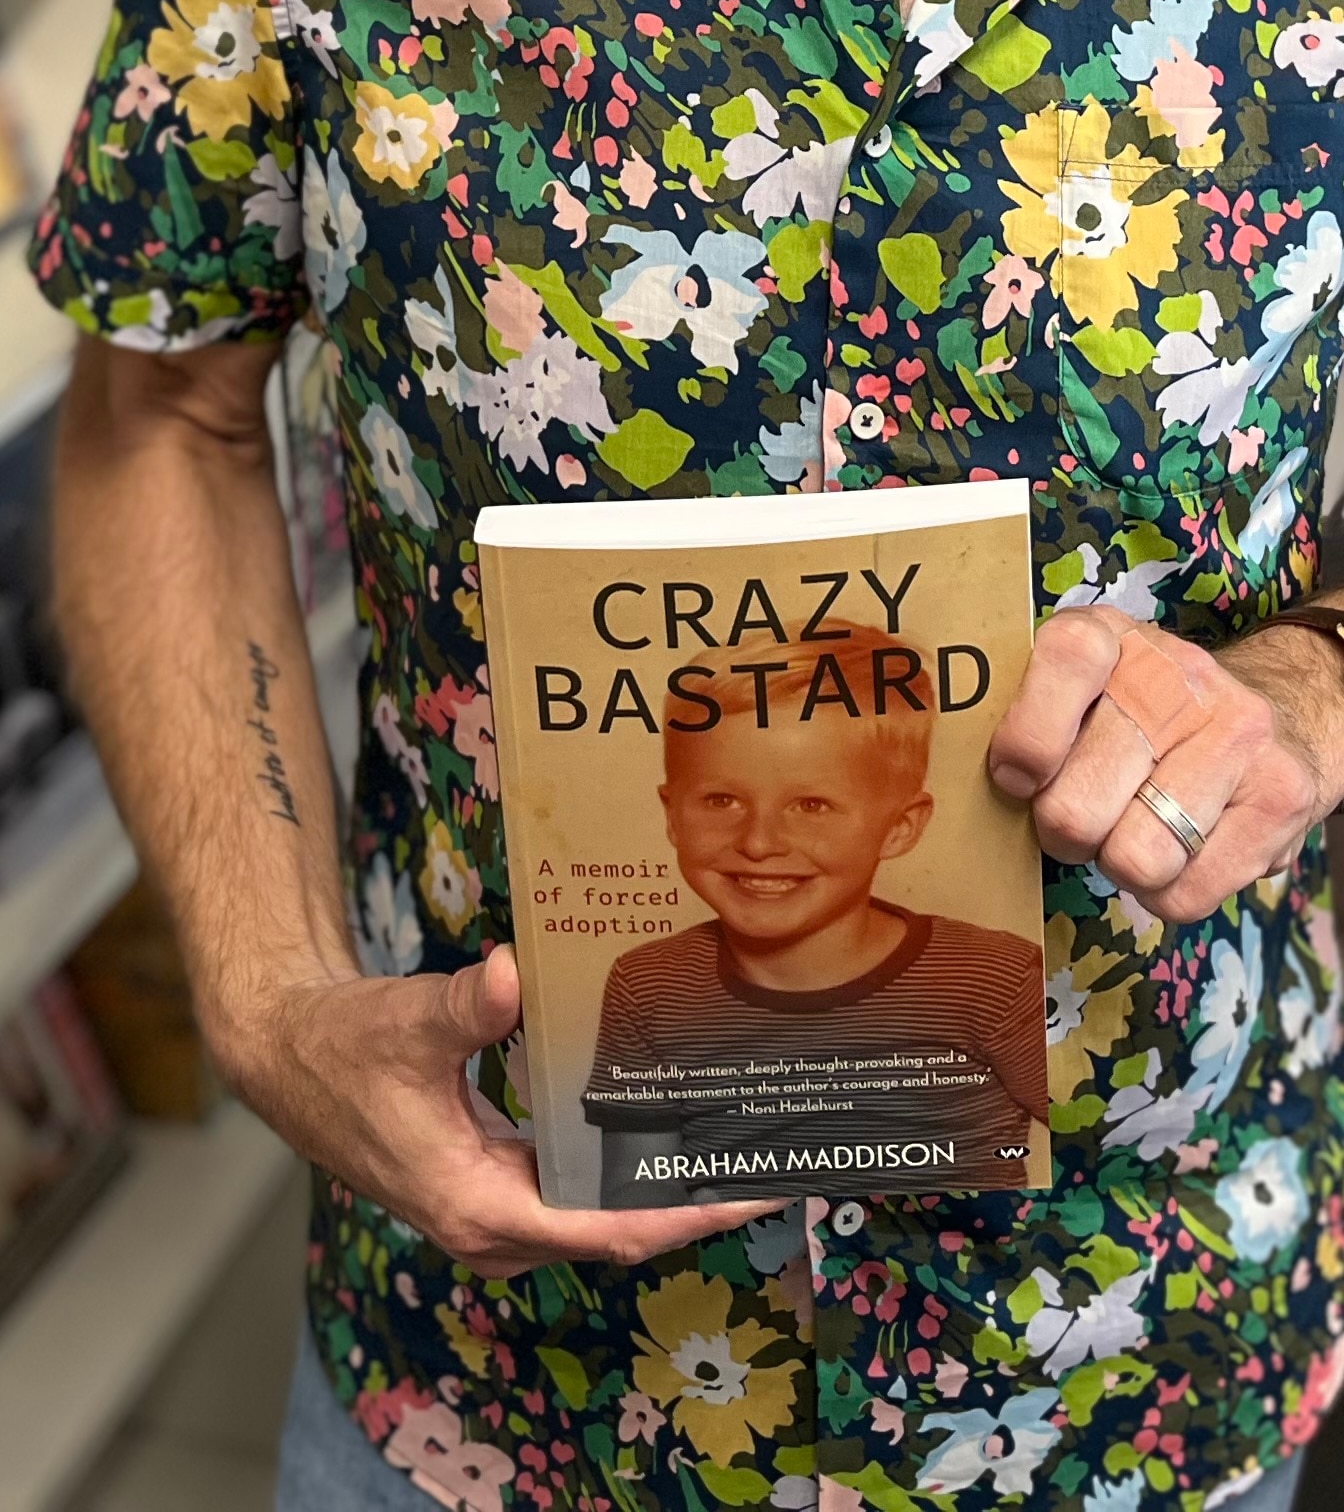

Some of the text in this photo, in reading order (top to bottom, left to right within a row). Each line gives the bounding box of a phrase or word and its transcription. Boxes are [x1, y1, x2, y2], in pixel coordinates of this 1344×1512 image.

[592, 563, 922, 650] CRAZY
[534, 644, 991, 734] BASTARD
[538, 859, 668, 878] A memoir
[534, 886, 678, 906] of forced
[544, 914, 673, 937] adoption
[689, 1066, 741, 1077] written,
[745, 1059, 792, 1076] deeply
[795, 1053, 923, 1073] thought-provoking
[926, 1049, 954, 1065] and
[958, 1053, 967, 1063] a
[586, 1086, 664, 1101] remarkable
[668, 1086, 737, 1100] testament
[741, 1086, 754, 1096] to
[758, 1080, 780, 1094] the
[842, 1078, 899, 1091] courage
[902, 1072, 929, 1087] and
[742, 1102, 776, 1115] Noni
[780, 1100, 854, 1114] Hazlehurst
[634, 1141, 955, 1181] ABRAHAM MADDISON
